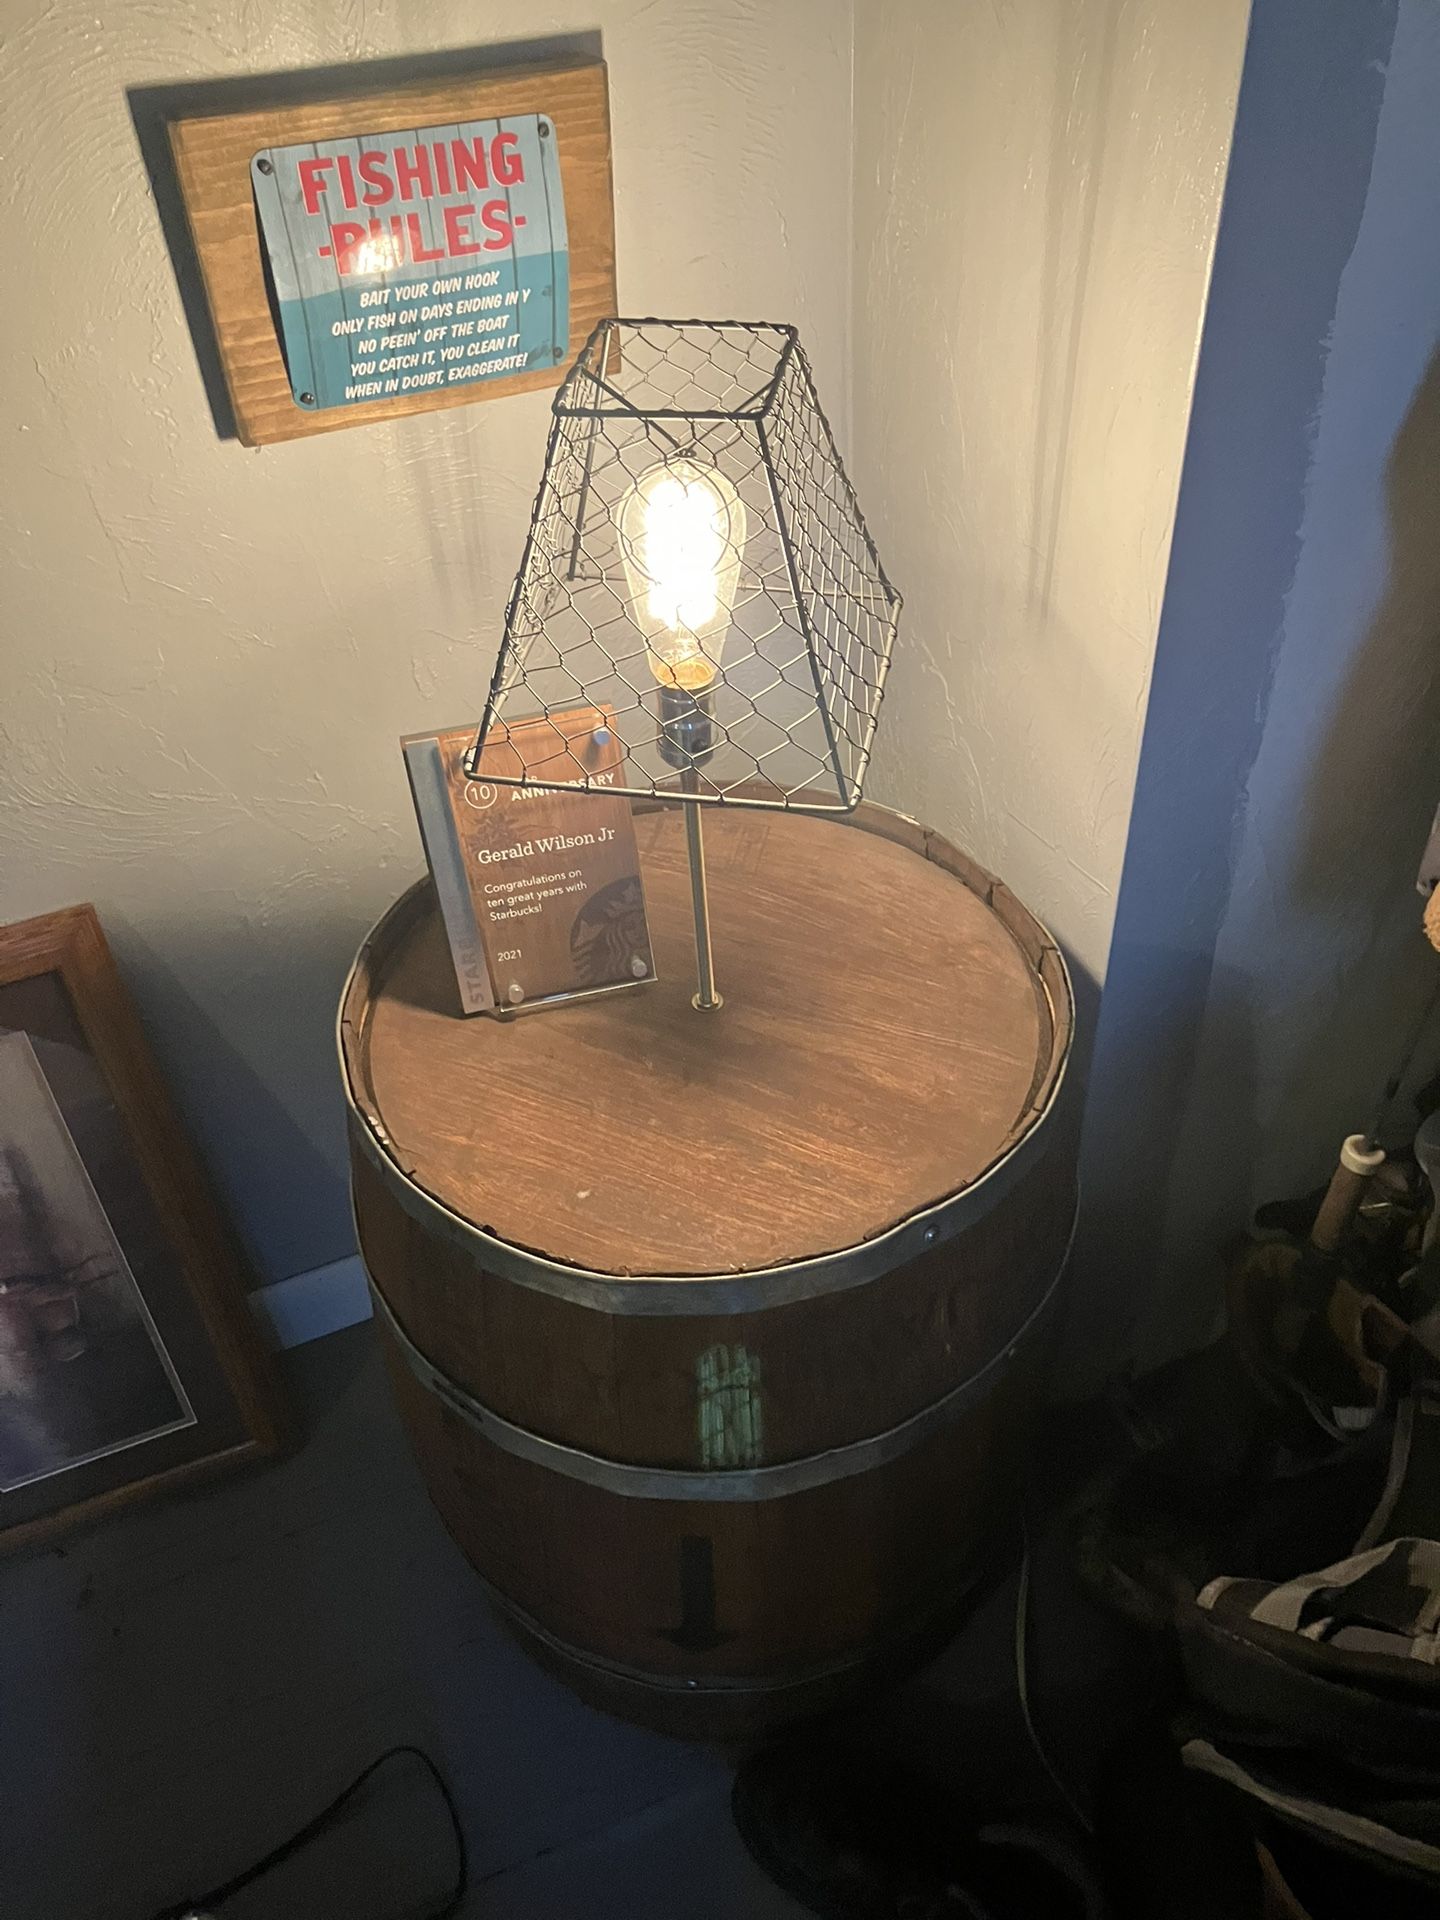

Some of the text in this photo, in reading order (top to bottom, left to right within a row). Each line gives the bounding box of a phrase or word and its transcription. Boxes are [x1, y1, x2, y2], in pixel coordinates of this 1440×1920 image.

[297, 131, 525, 216] FISHING
[360, 270, 500, 308] BAIT YOUR OWN HOOK
[332, 288, 531, 336] ONLY FISH ON DAYS ENDING IN Y
[358, 339, 377, 354] NO
[424, 326, 448, 343] OFF
[451, 321, 475, 338] THE
[477, 314, 510, 334] BOAT
[351, 333, 520, 377] YOU CATCH IT, YOU CLEAN IT
[345, 352, 529, 399] WHEN IN DOUBT, EXAGGERATE!
[470, 785, 491, 801] 10
[478, 827, 616, 864] Gerald Wilson Jr
[484, 869, 582, 894] Congratulations on
[487, 880, 587, 908] ten great years with
[489, 903, 542, 921] Starbucks!
[497, 949, 522, 962] 2021
